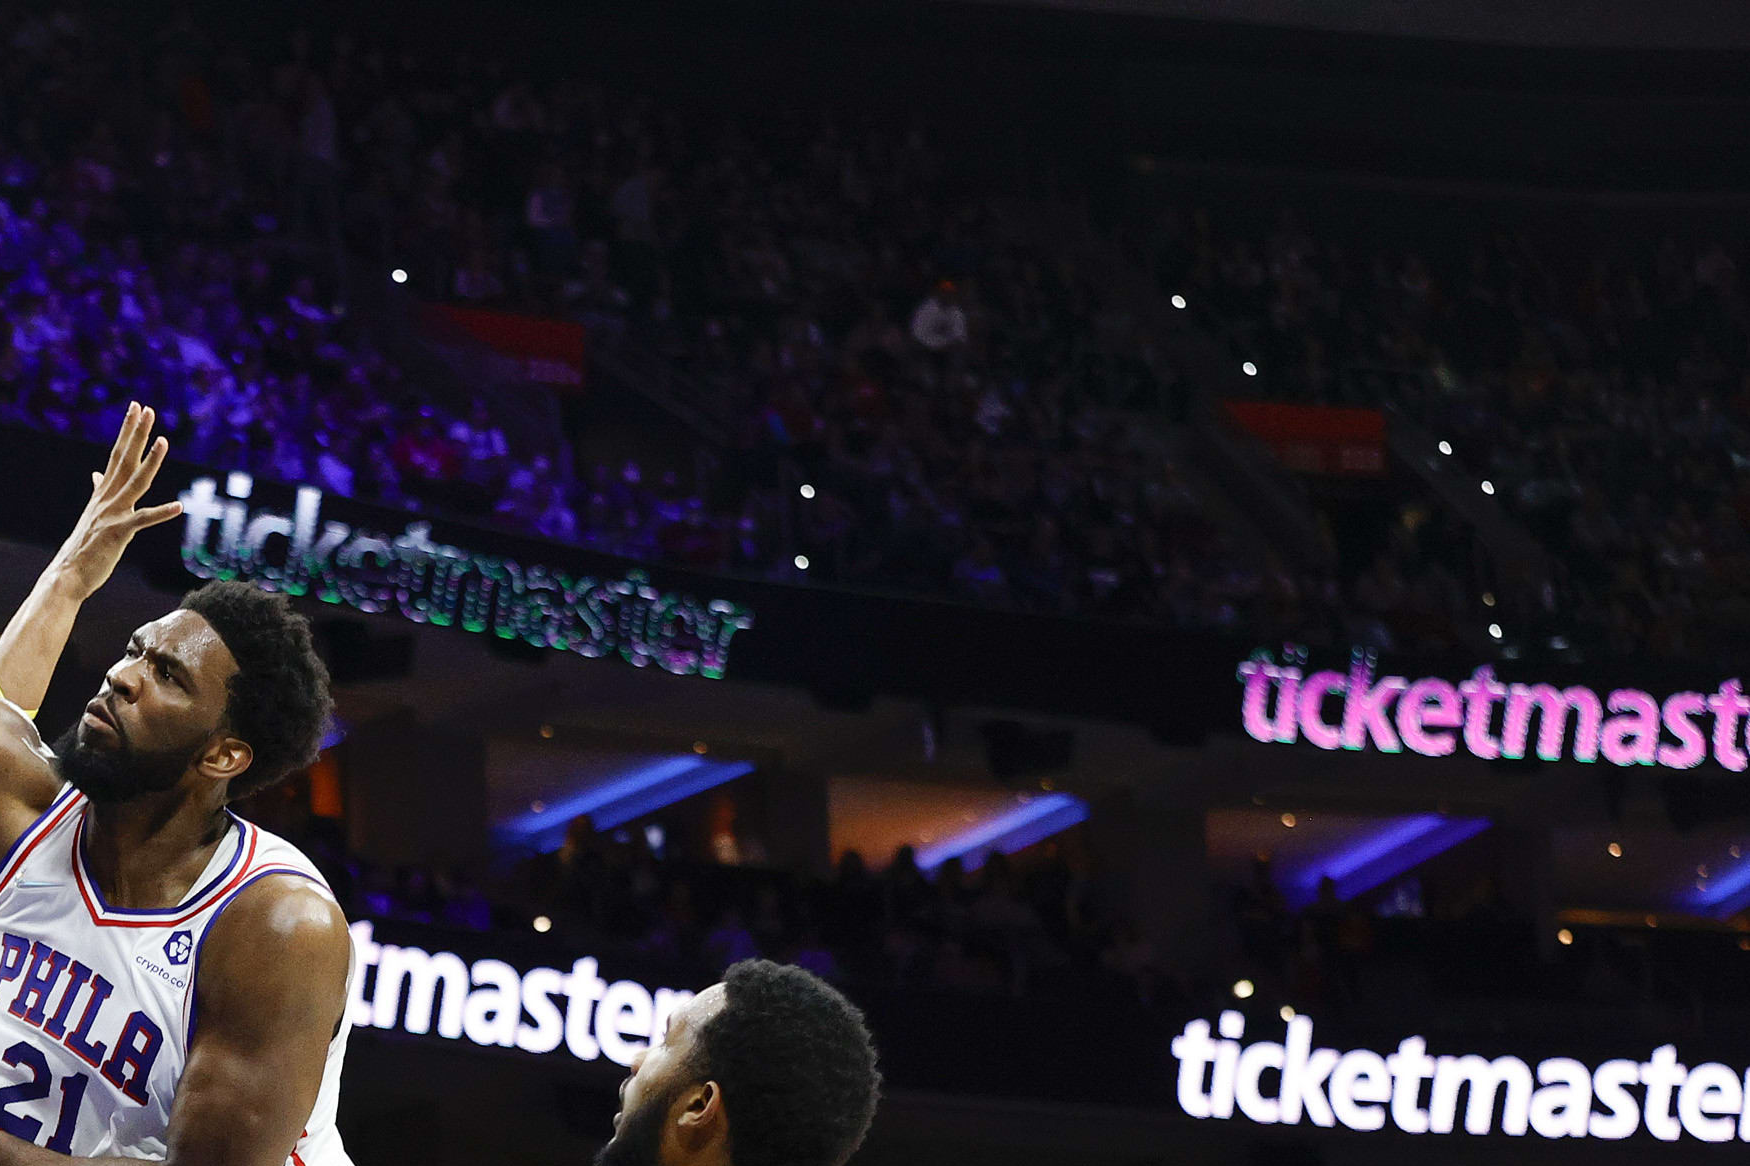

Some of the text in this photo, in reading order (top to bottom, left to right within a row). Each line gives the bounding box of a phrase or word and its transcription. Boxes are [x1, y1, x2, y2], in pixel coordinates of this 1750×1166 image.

[1237, 642, 1750, 772] ticketmast
[135, 955, 187, 990] crypto.co
[1171, 1009, 1750, 1142] ticketmaste
